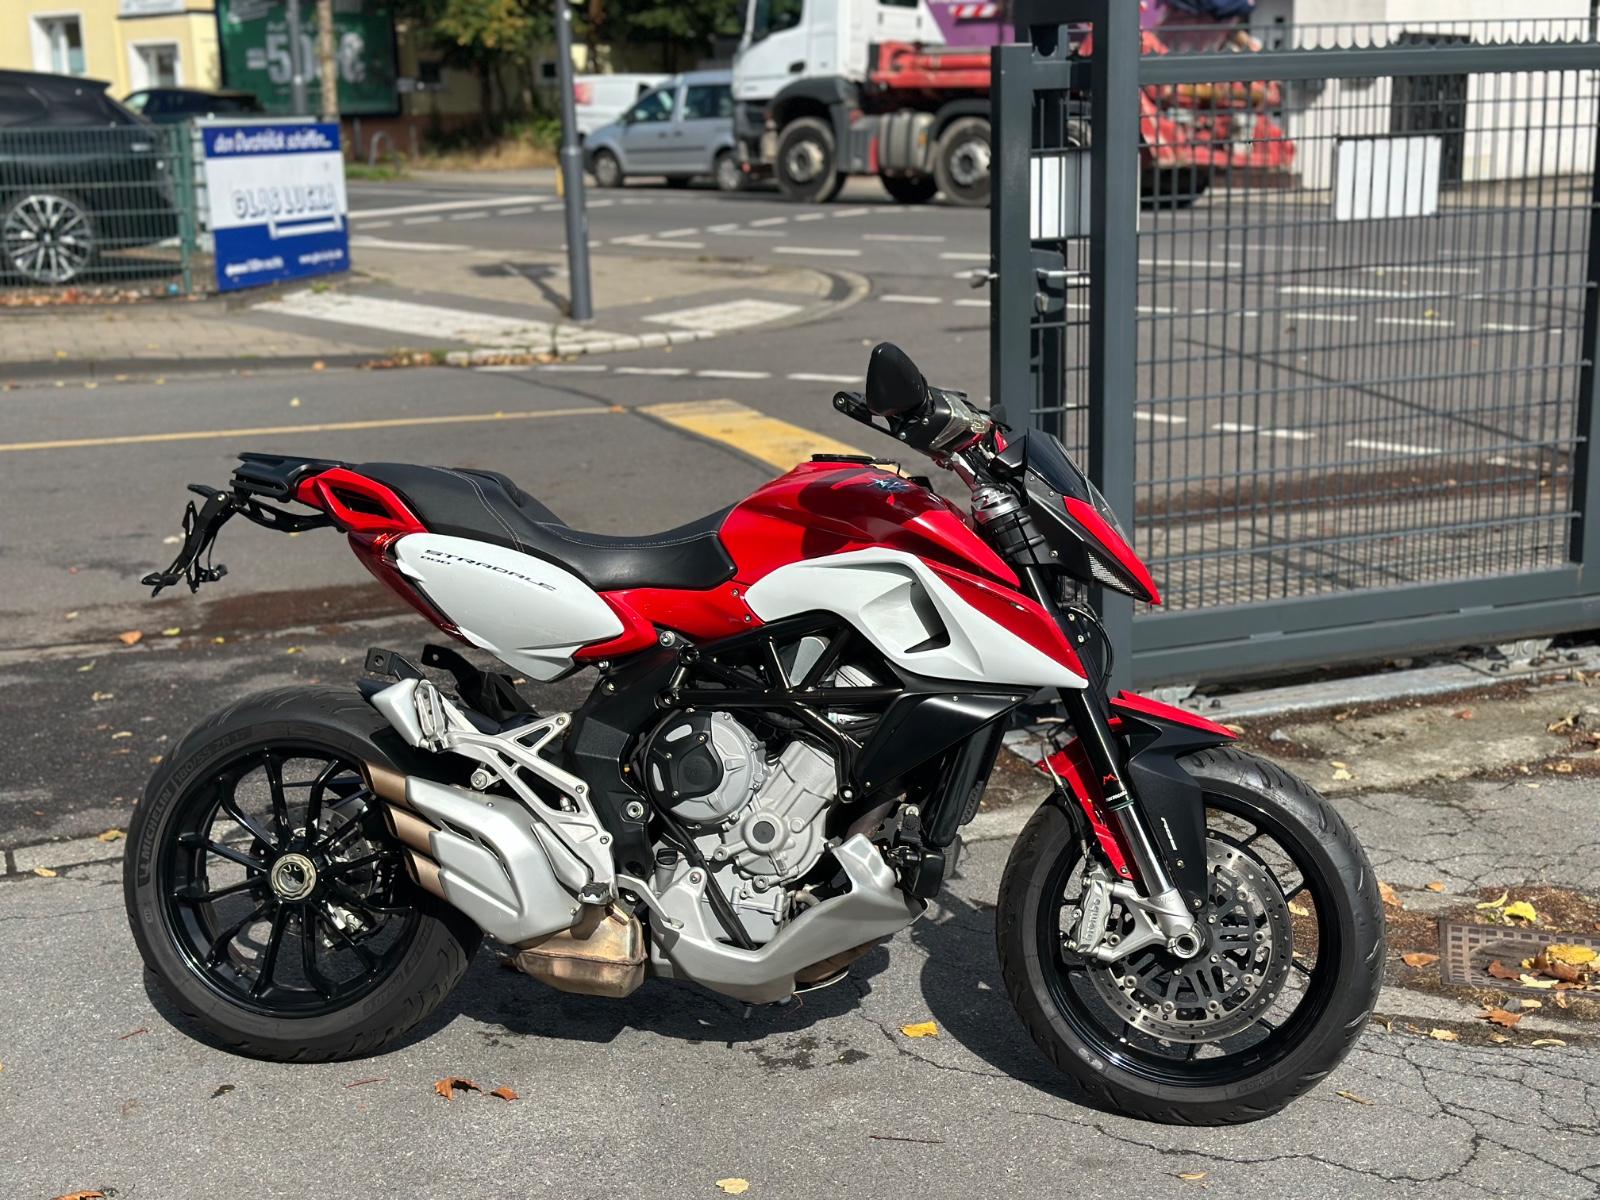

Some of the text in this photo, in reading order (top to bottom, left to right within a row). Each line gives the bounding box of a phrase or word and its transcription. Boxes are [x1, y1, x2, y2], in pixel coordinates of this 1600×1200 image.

[425, 549, 557, 592] STRADALE
[140, 788, 173, 861] MICHELIN
[1082, 898, 1101, 942] brembo
